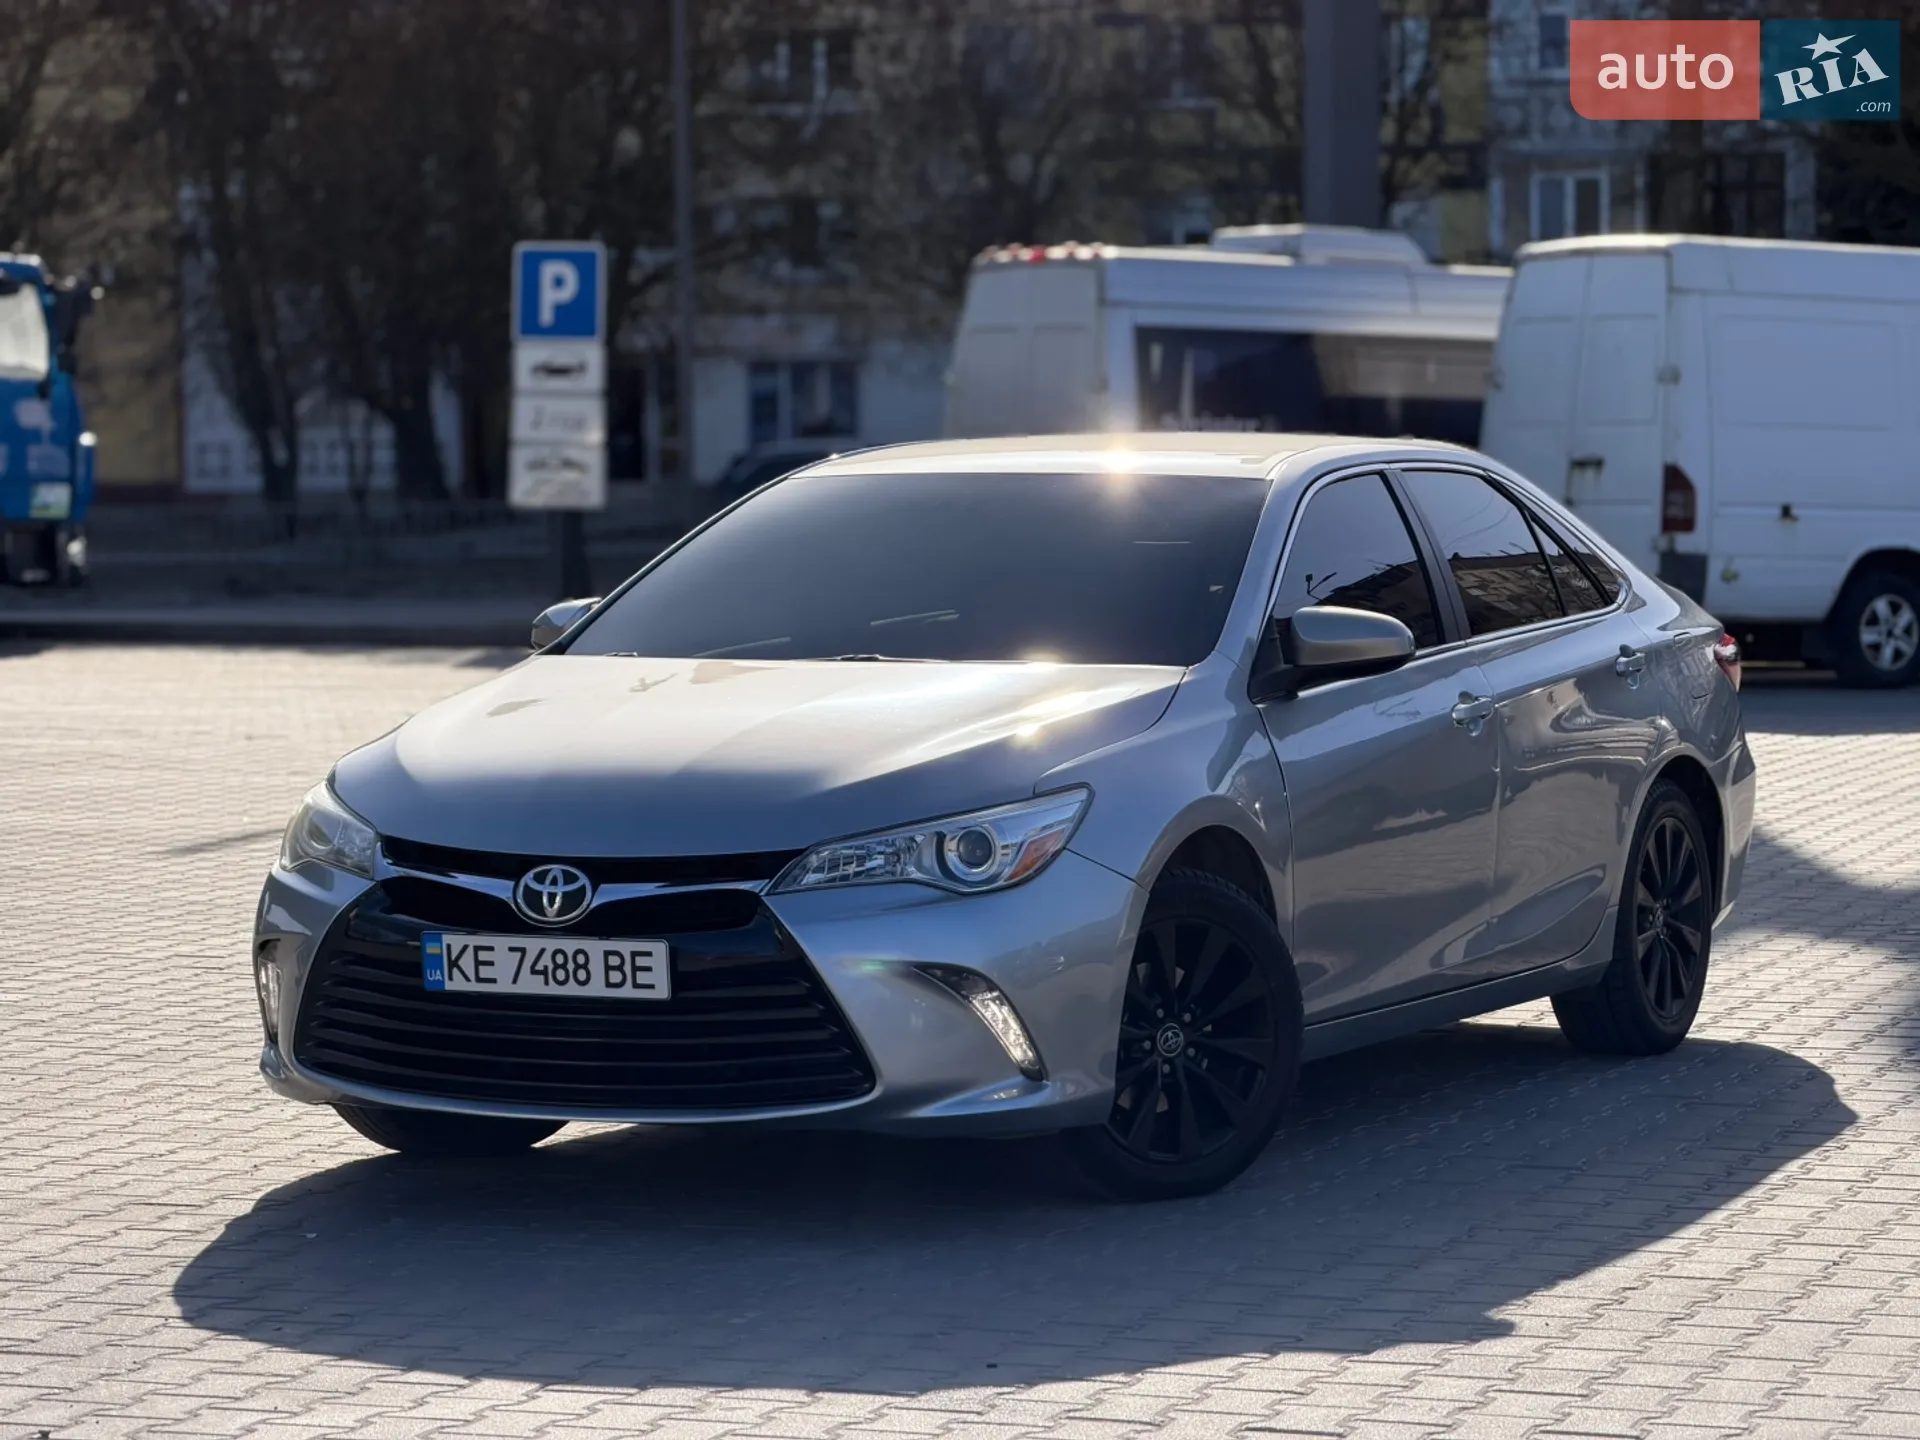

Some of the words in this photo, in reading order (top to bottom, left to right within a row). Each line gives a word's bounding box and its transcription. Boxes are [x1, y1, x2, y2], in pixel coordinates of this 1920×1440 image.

[538, 258, 580, 328] P
[426, 968, 443, 981] UA
[445, 943, 498, 984] KE
[507, 946, 592, 987] 7488
[602, 949, 656, 990] BE
